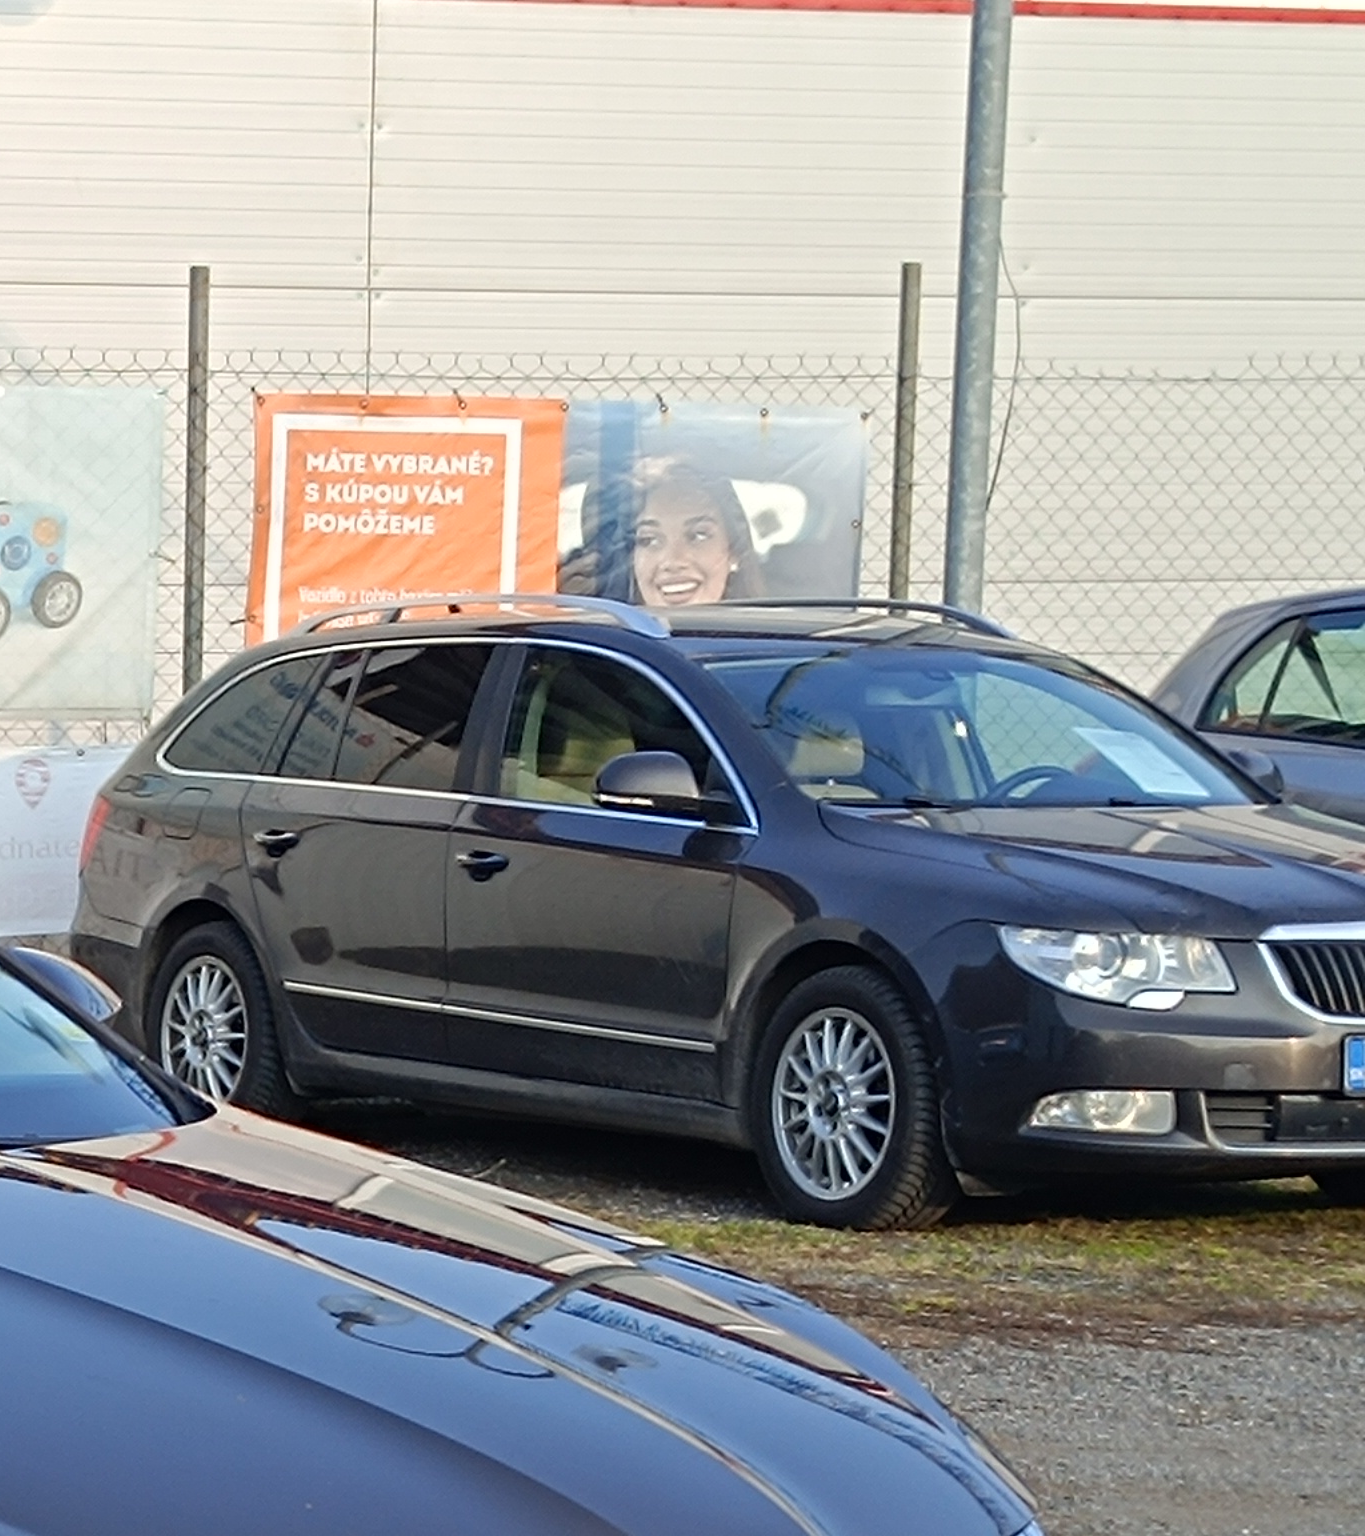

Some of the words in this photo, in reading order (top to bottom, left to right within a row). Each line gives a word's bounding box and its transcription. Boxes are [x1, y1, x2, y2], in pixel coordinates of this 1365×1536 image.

[305, 447, 367, 474] MÁTE
[371, 449, 495, 476] VYBRANÉ?
[304, 481, 319, 503] S
[325, 478, 409, 504] KÚPOU
[413, 480, 465, 505] VÁM
[303, 507, 436, 535] POMÔŽEME
